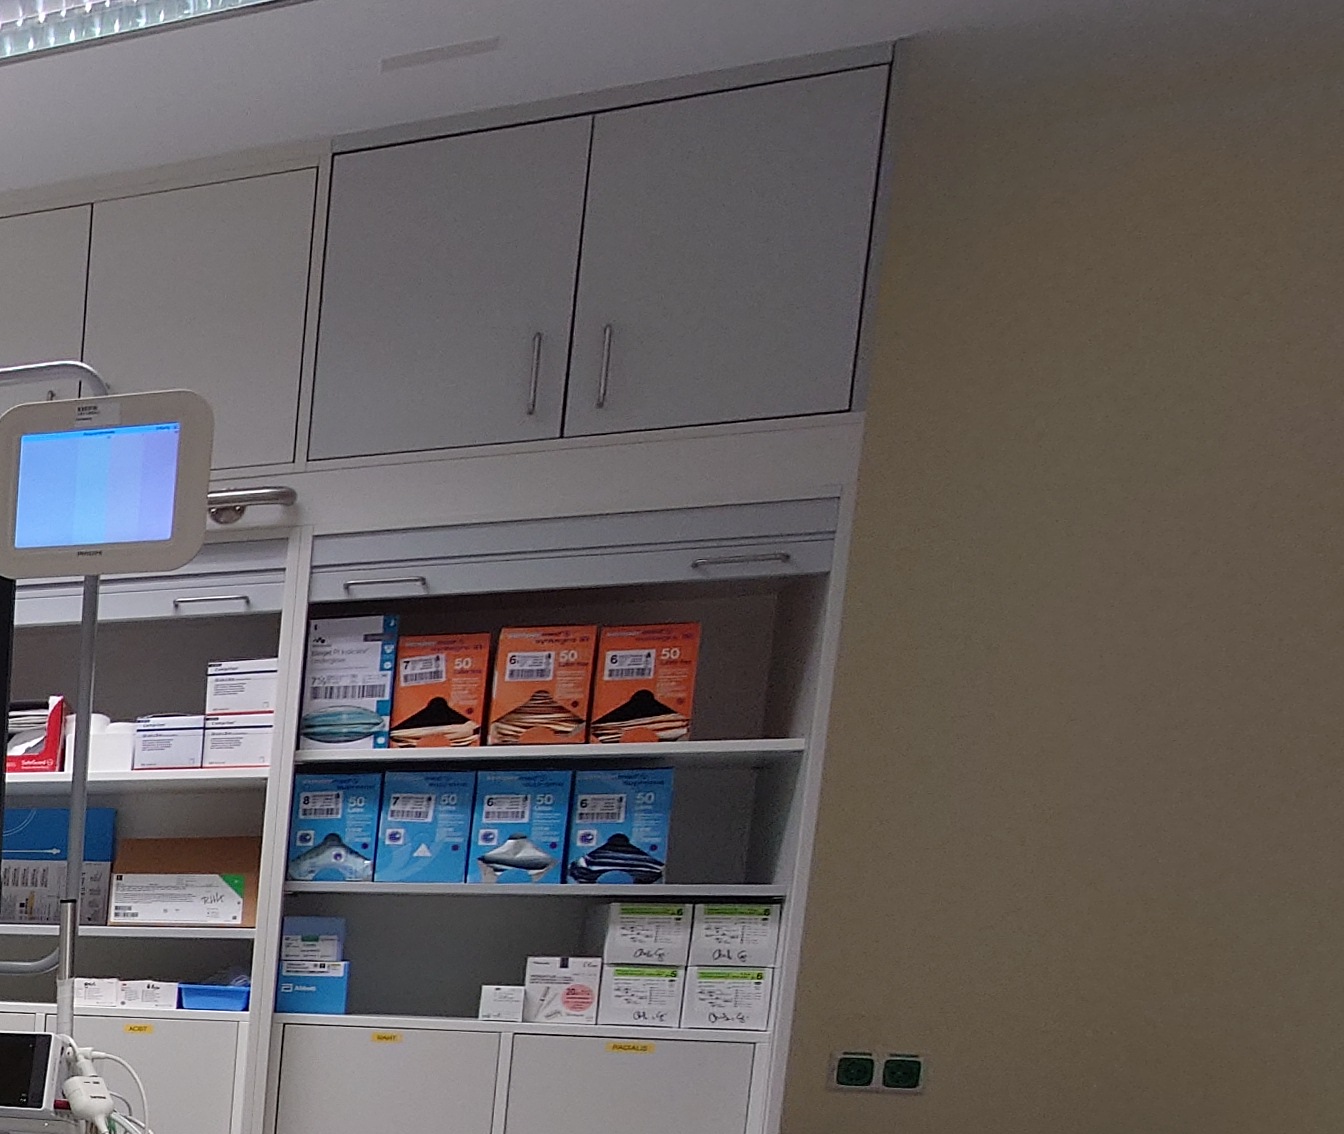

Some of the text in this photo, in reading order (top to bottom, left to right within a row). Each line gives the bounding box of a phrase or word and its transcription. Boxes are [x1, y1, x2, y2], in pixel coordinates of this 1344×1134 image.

[559, 650, 578, 662] 50
[661, 647, 680, 660] 50
[454, 657, 472, 669] 50
[348, 797, 365, 807] 50
[440, 794, 457, 805] 50
[536, 794, 553, 805] 50
[636, 792, 654, 804] 50
